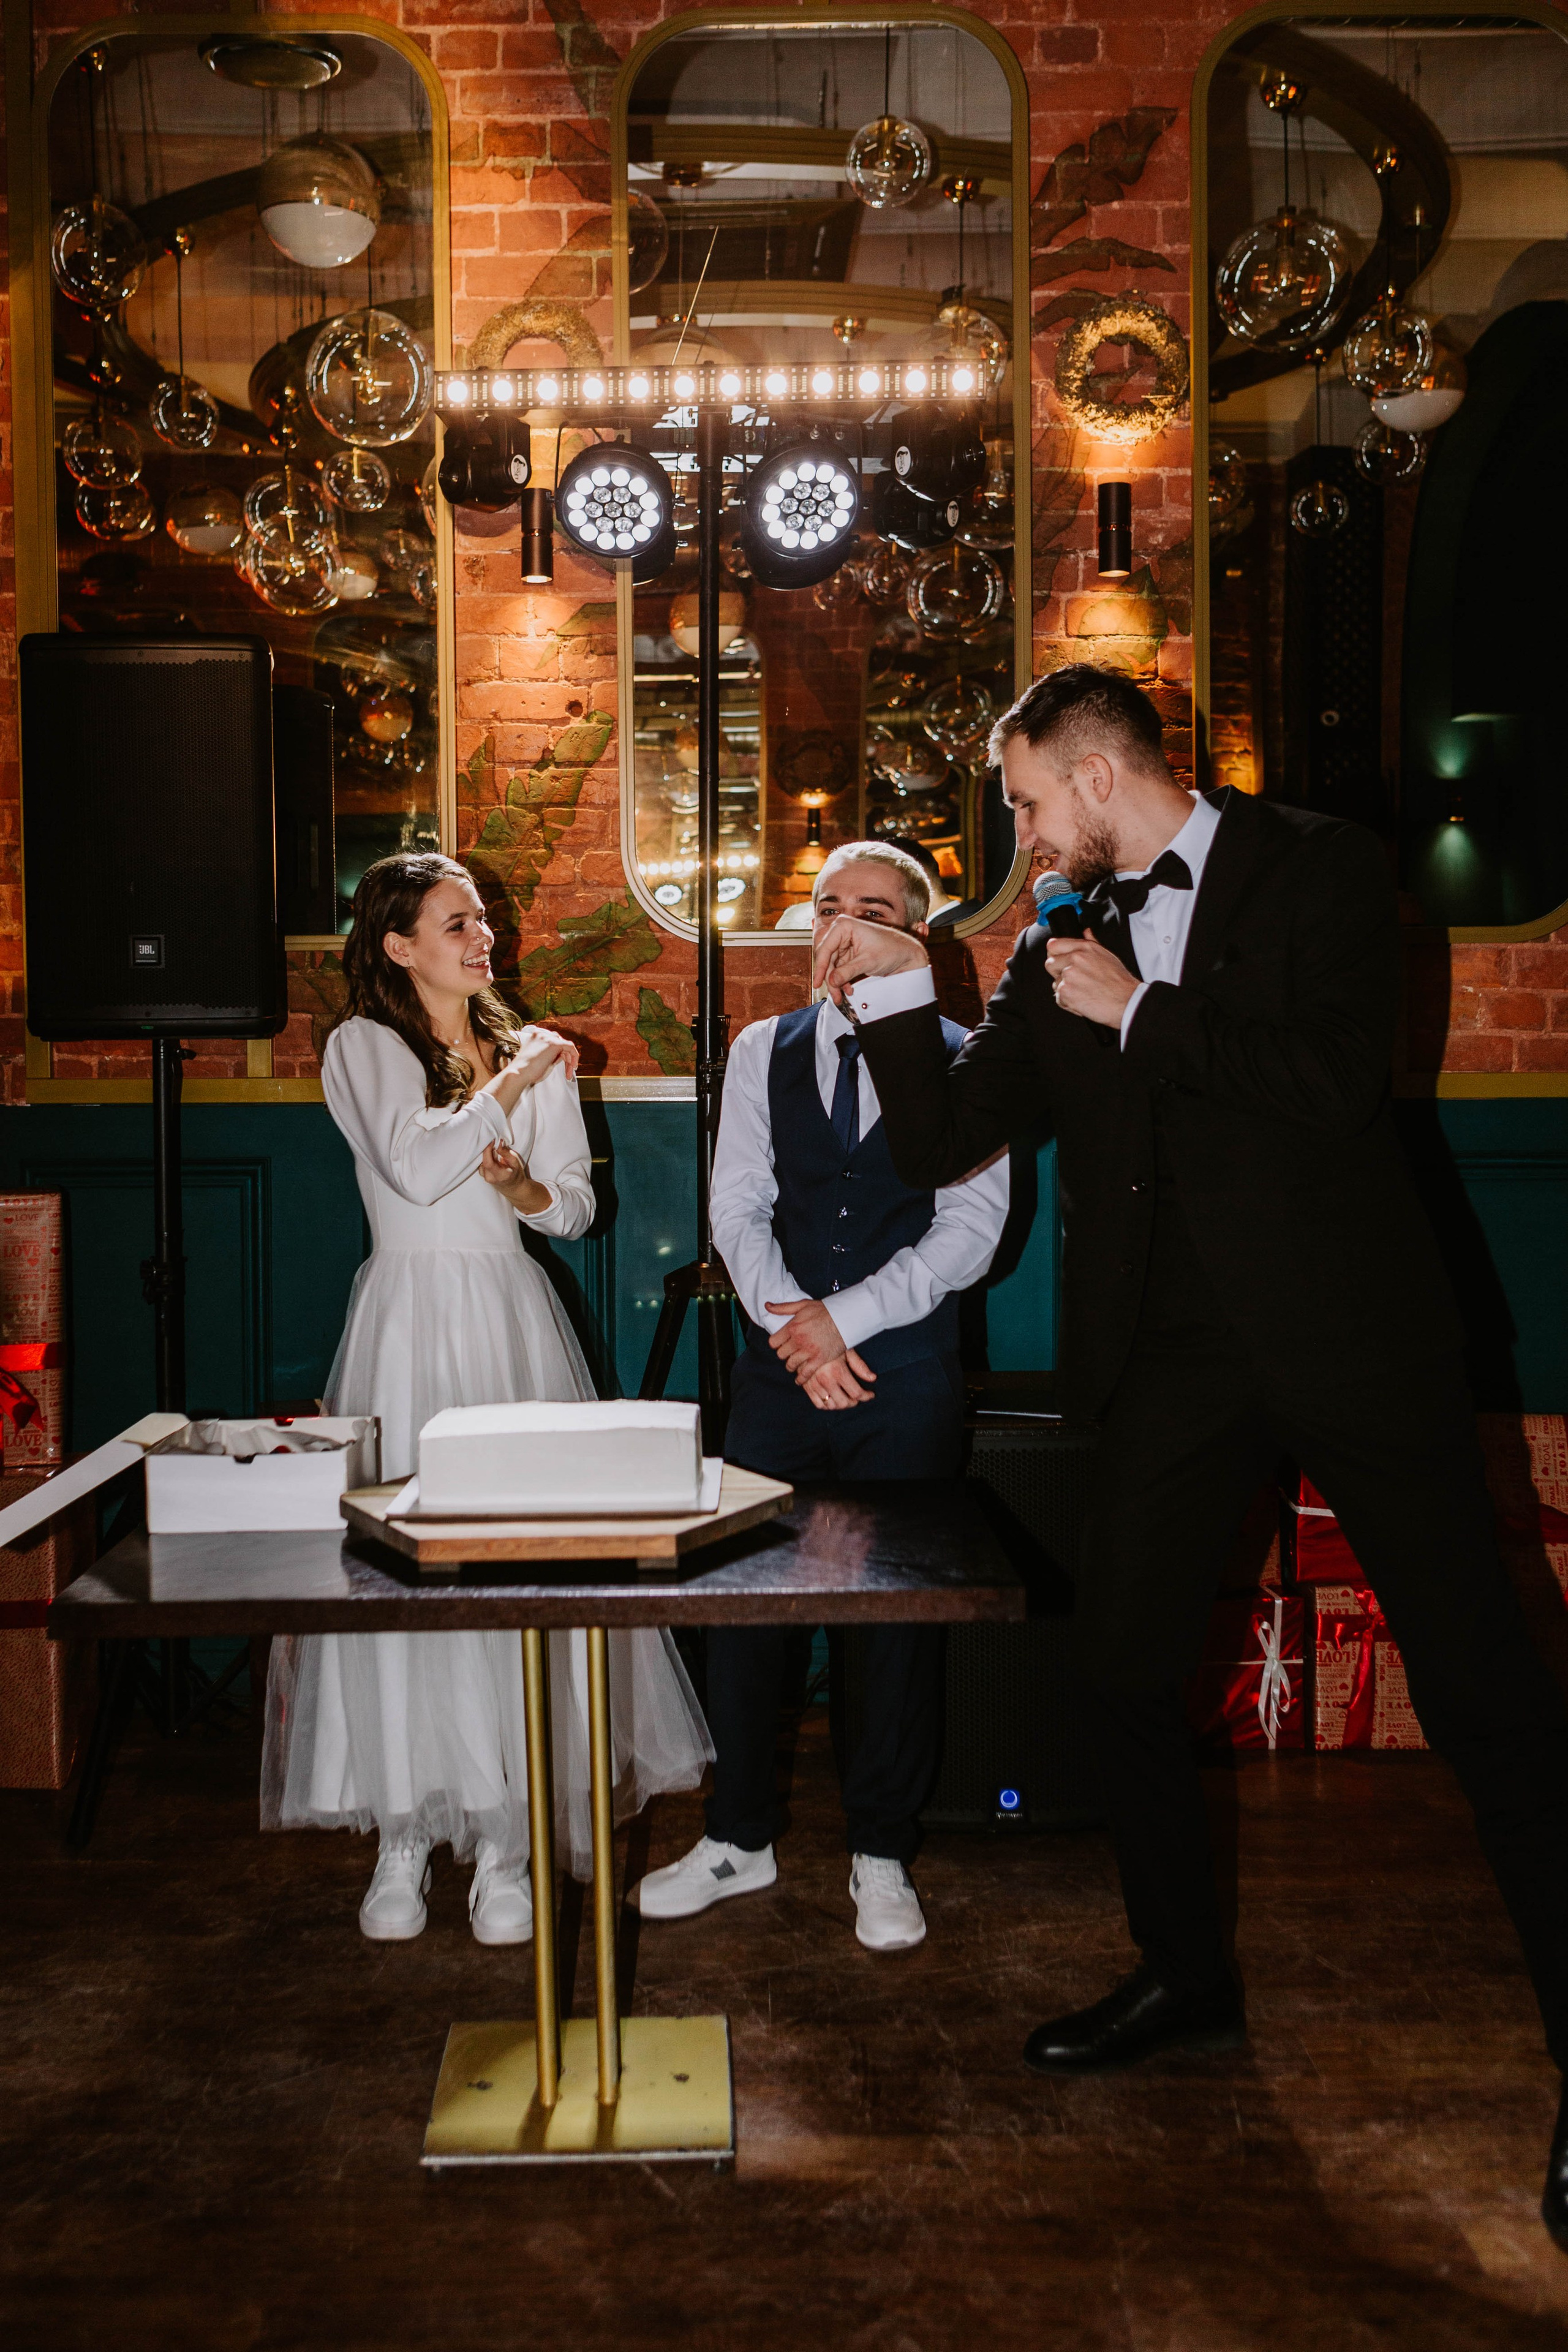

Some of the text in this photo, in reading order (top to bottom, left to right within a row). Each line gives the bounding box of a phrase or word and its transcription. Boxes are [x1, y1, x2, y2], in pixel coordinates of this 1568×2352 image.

[139, 944, 155, 954] JBL
[4, 1245, 40, 1257] LOVE
[5, 1434, 42, 1447] LOVE
